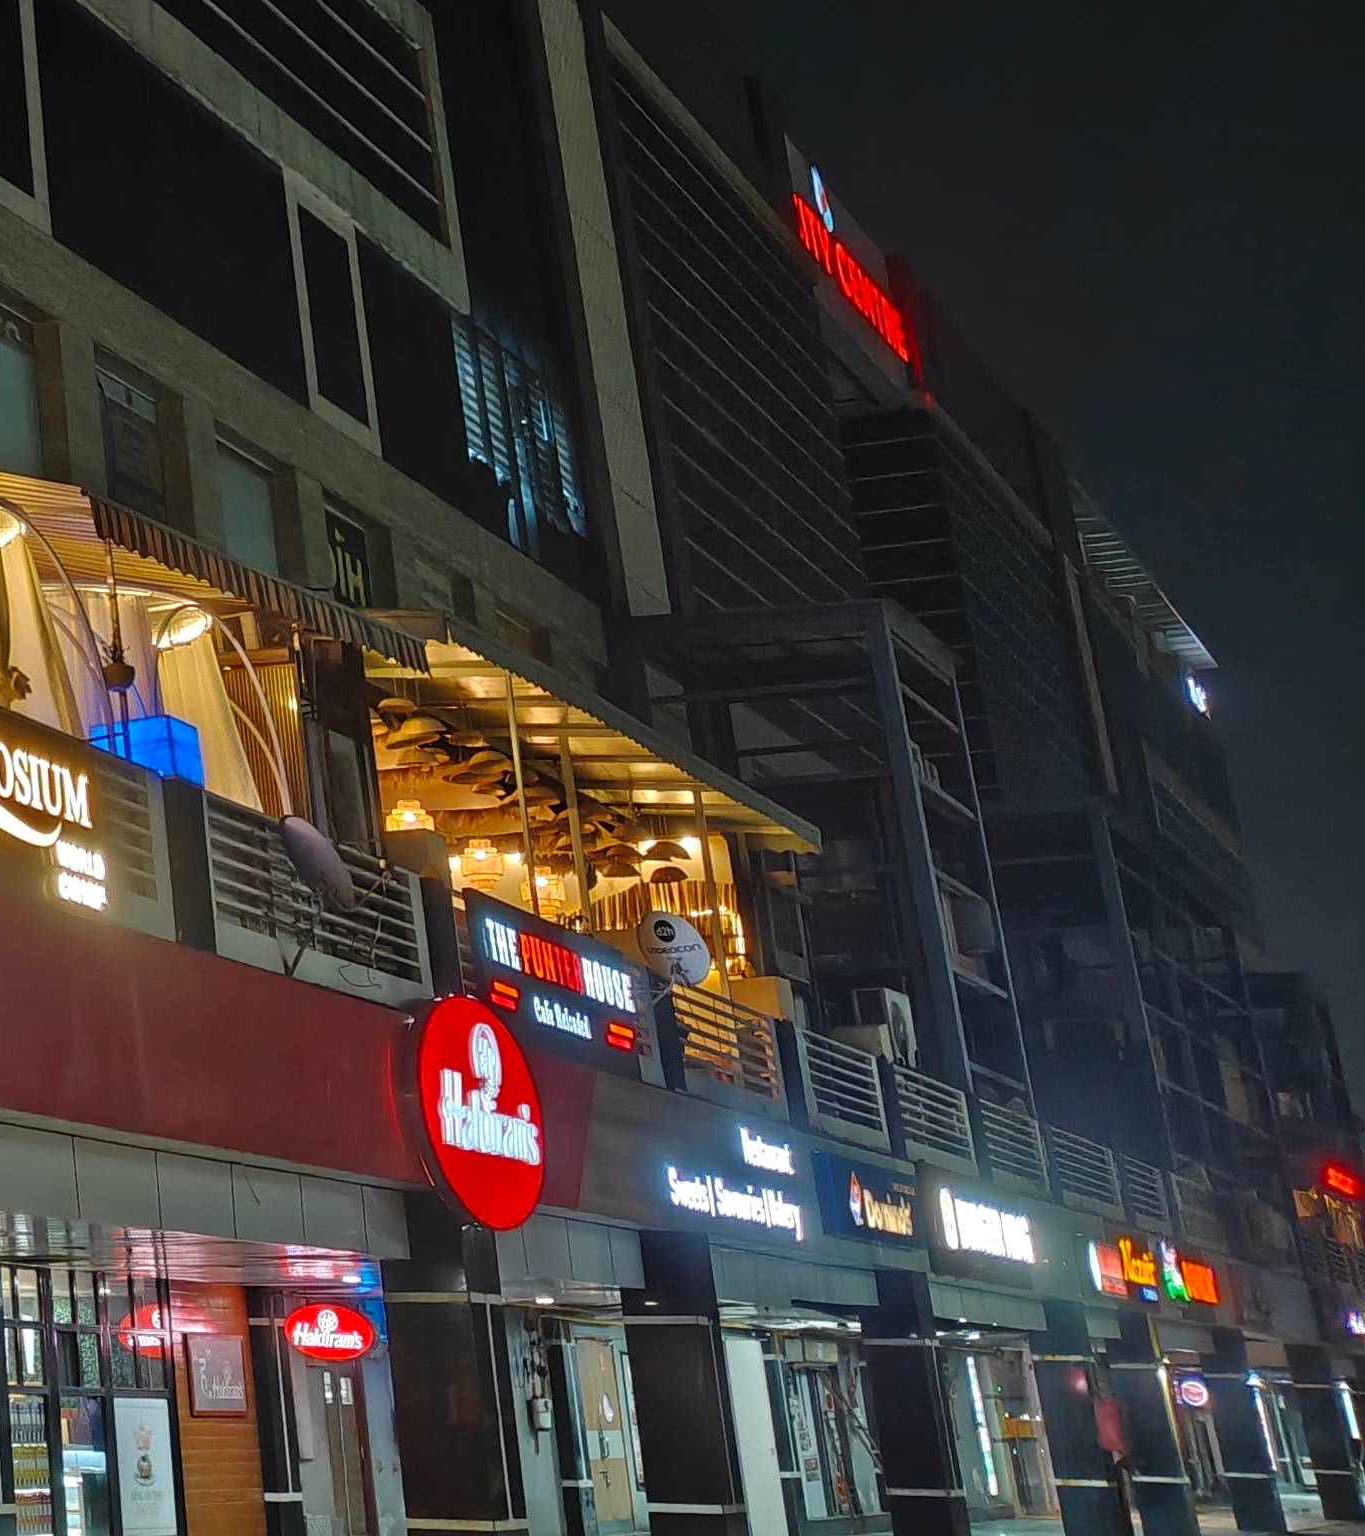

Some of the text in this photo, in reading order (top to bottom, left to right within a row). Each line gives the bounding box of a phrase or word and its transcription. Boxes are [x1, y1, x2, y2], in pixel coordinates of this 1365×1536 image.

[484, 917, 637, 1014] THE PUNTER HOUSE
[292, 1321, 363, 1351] Haldiram's
